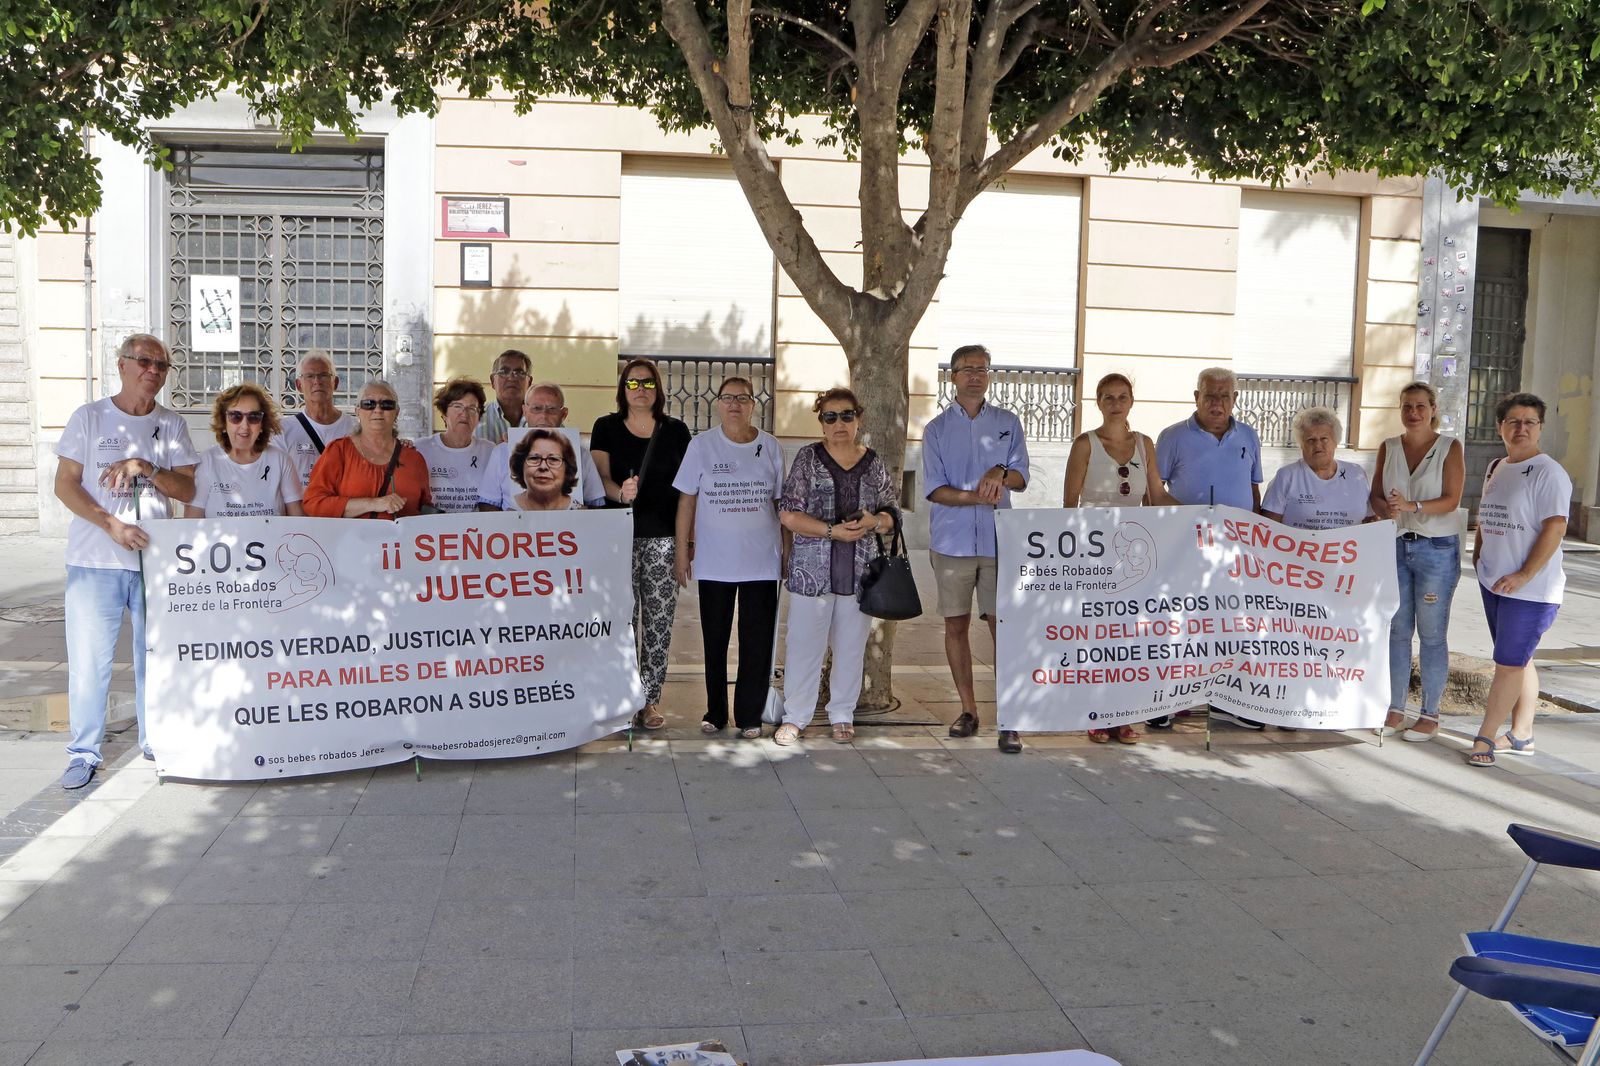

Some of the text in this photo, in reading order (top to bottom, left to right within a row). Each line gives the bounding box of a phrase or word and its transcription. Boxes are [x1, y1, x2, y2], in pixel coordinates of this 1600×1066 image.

[382, 528, 578, 570] ¡¡ SEÑORES
[1026, 530, 1105, 558] S.O.S
[1196, 518, 1358, 564] ¡¡ SEÑORES
[176, 542, 266, 574] S.O.S
[1020, 564, 1112, 576] Bebés Robados
[168, 580, 276, 596] Bebés Robados
[416, 568, 583, 602] JUECES !!
[1018, 580, 1117, 591] Jerez de la Frontera
[1334, 574, 1355, 594] !!
[168, 598, 282, 612] Jerez de la Frontera
[1082, 600, 1140, 618] ESTOS
[1144, 596, 1210, 614] CASOS
[1215, 594, 1240, 610] NO
[178, 618, 612, 661] PEDIMOS VERDAD, JUSTICIA Y REPARACIÓN
[1046, 617, 1360, 643] SON DELITOS DE LESA HUNIDAD
[1060, 652, 1070, 668] ¿
[1076, 645, 1142, 664] DONDE
[1148, 638, 1208, 660] ESTÁN
[1214, 640, 1300, 656] NUESTROS
[1335, 648, 1344, 662] ?
[268, 654, 545, 690] PARA MILES DE MADRES
[1032, 658, 1365, 684] QUEREMOS VERLOS ANTES DE MRIR
[1152, 674, 1286, 703] ¡¡ JUSTICIA YA !!
[234, 680, 575, 726] QUE LES ROBARON A SUS BEBÉS
[1116, 708, 1140, 718] bebes
[1141, 704, 1172, 714] robados
[1173, 700, 1194, 710] Jerez
[268, 746, 385, 764] sos bebes robados Jerez
